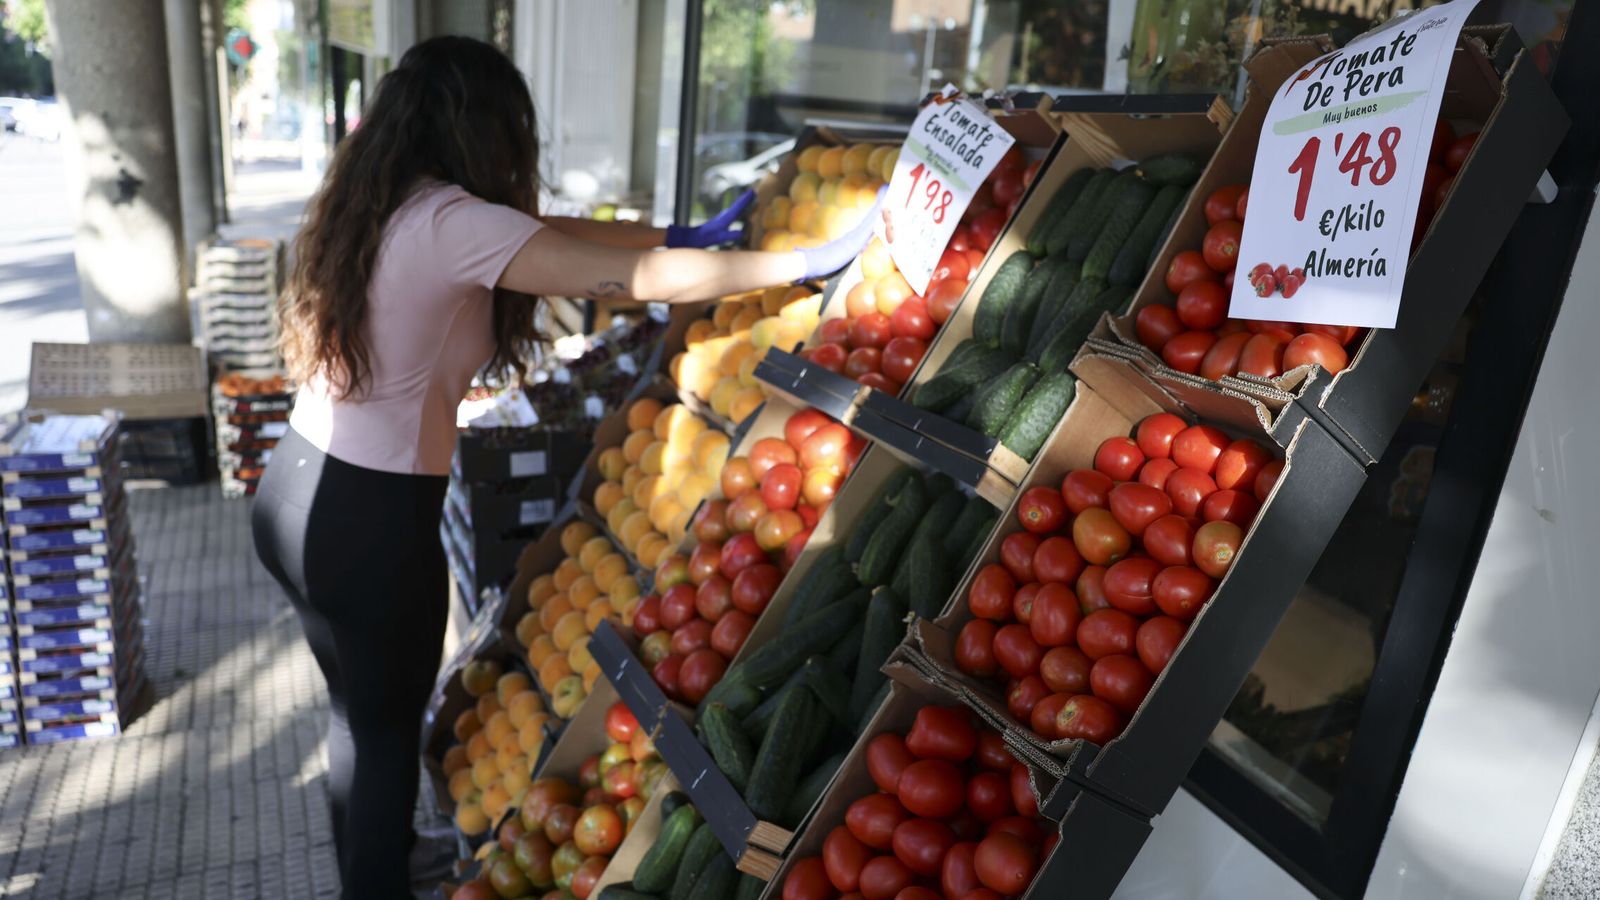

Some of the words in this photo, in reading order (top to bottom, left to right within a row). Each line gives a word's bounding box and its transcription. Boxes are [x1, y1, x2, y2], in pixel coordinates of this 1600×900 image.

[1320, 30, 1418, 80] Tomate
[1303, 81, 1334, 112] De
[1343, 66, 1404, 102] Pera
[943, 101, 994, 149] Tomate
[1322, 111, 1342, 125] Muy
[1344, 103, 1378, 119] buenos
[924, 114, 984, 169] Ensalada
[906, 162, 953, 225] 1'98
[1288, 126, 1401, 222] 1'48
[1319, 200, 1385, 242] €/kilo
[1303, 248, 1387, 278] Almería
